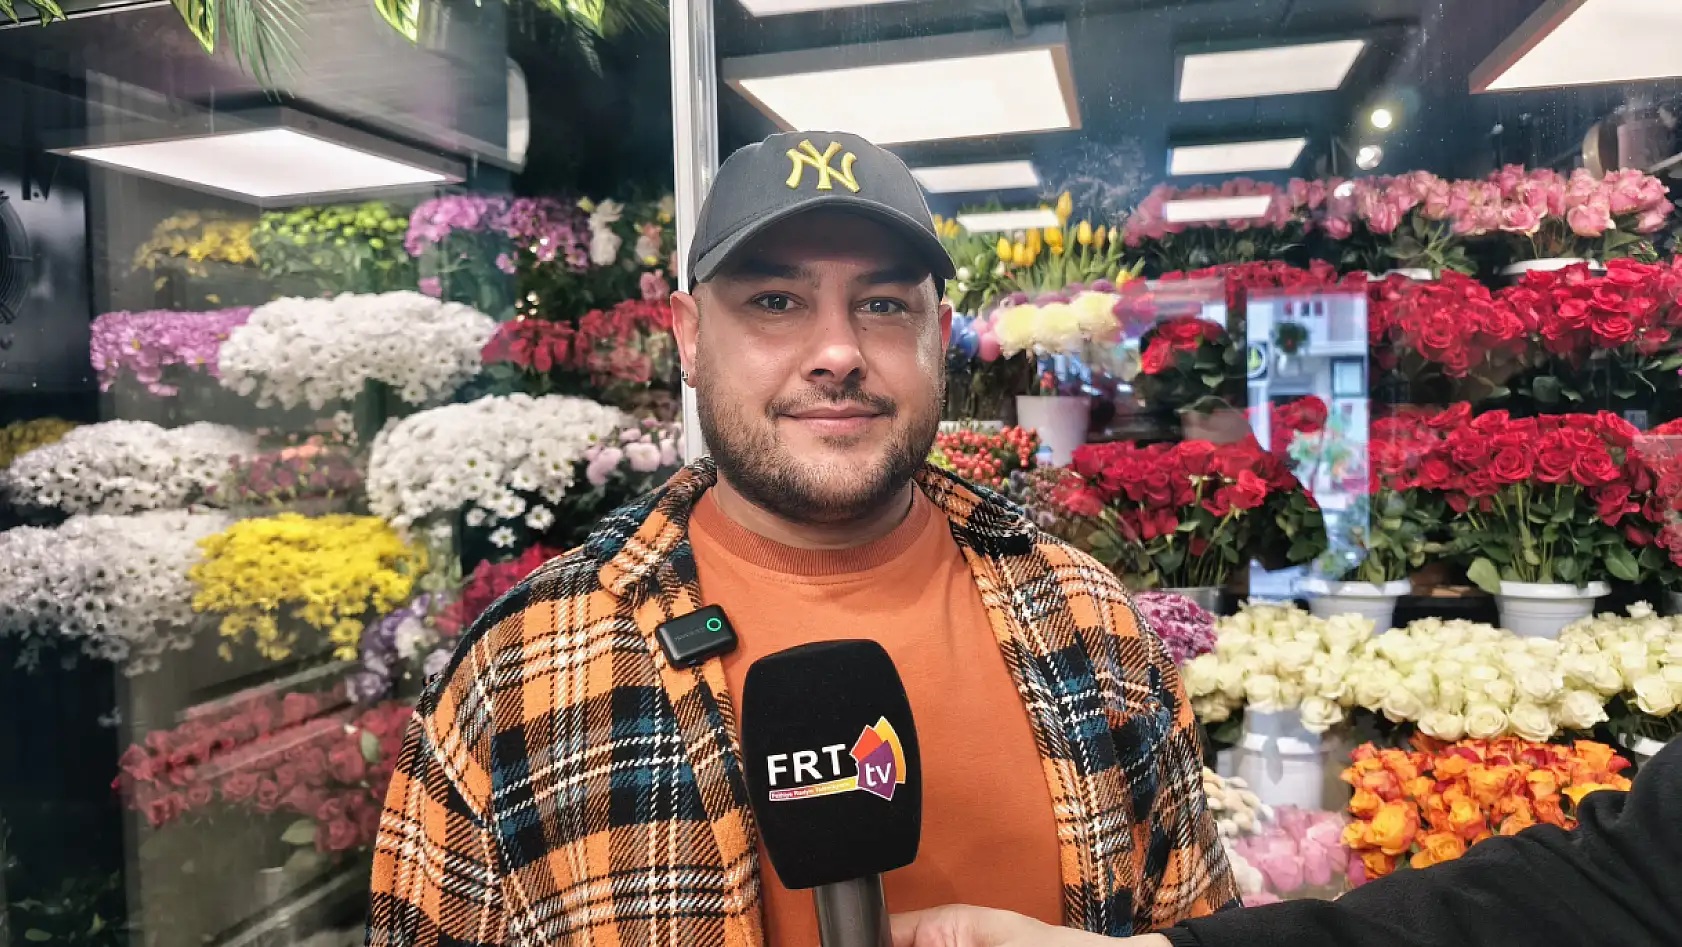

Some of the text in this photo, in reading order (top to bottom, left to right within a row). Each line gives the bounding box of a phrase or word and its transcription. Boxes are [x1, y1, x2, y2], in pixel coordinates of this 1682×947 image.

[785, 139, 860, 193] NY
[767, 744, 892, 787] FRT tv
